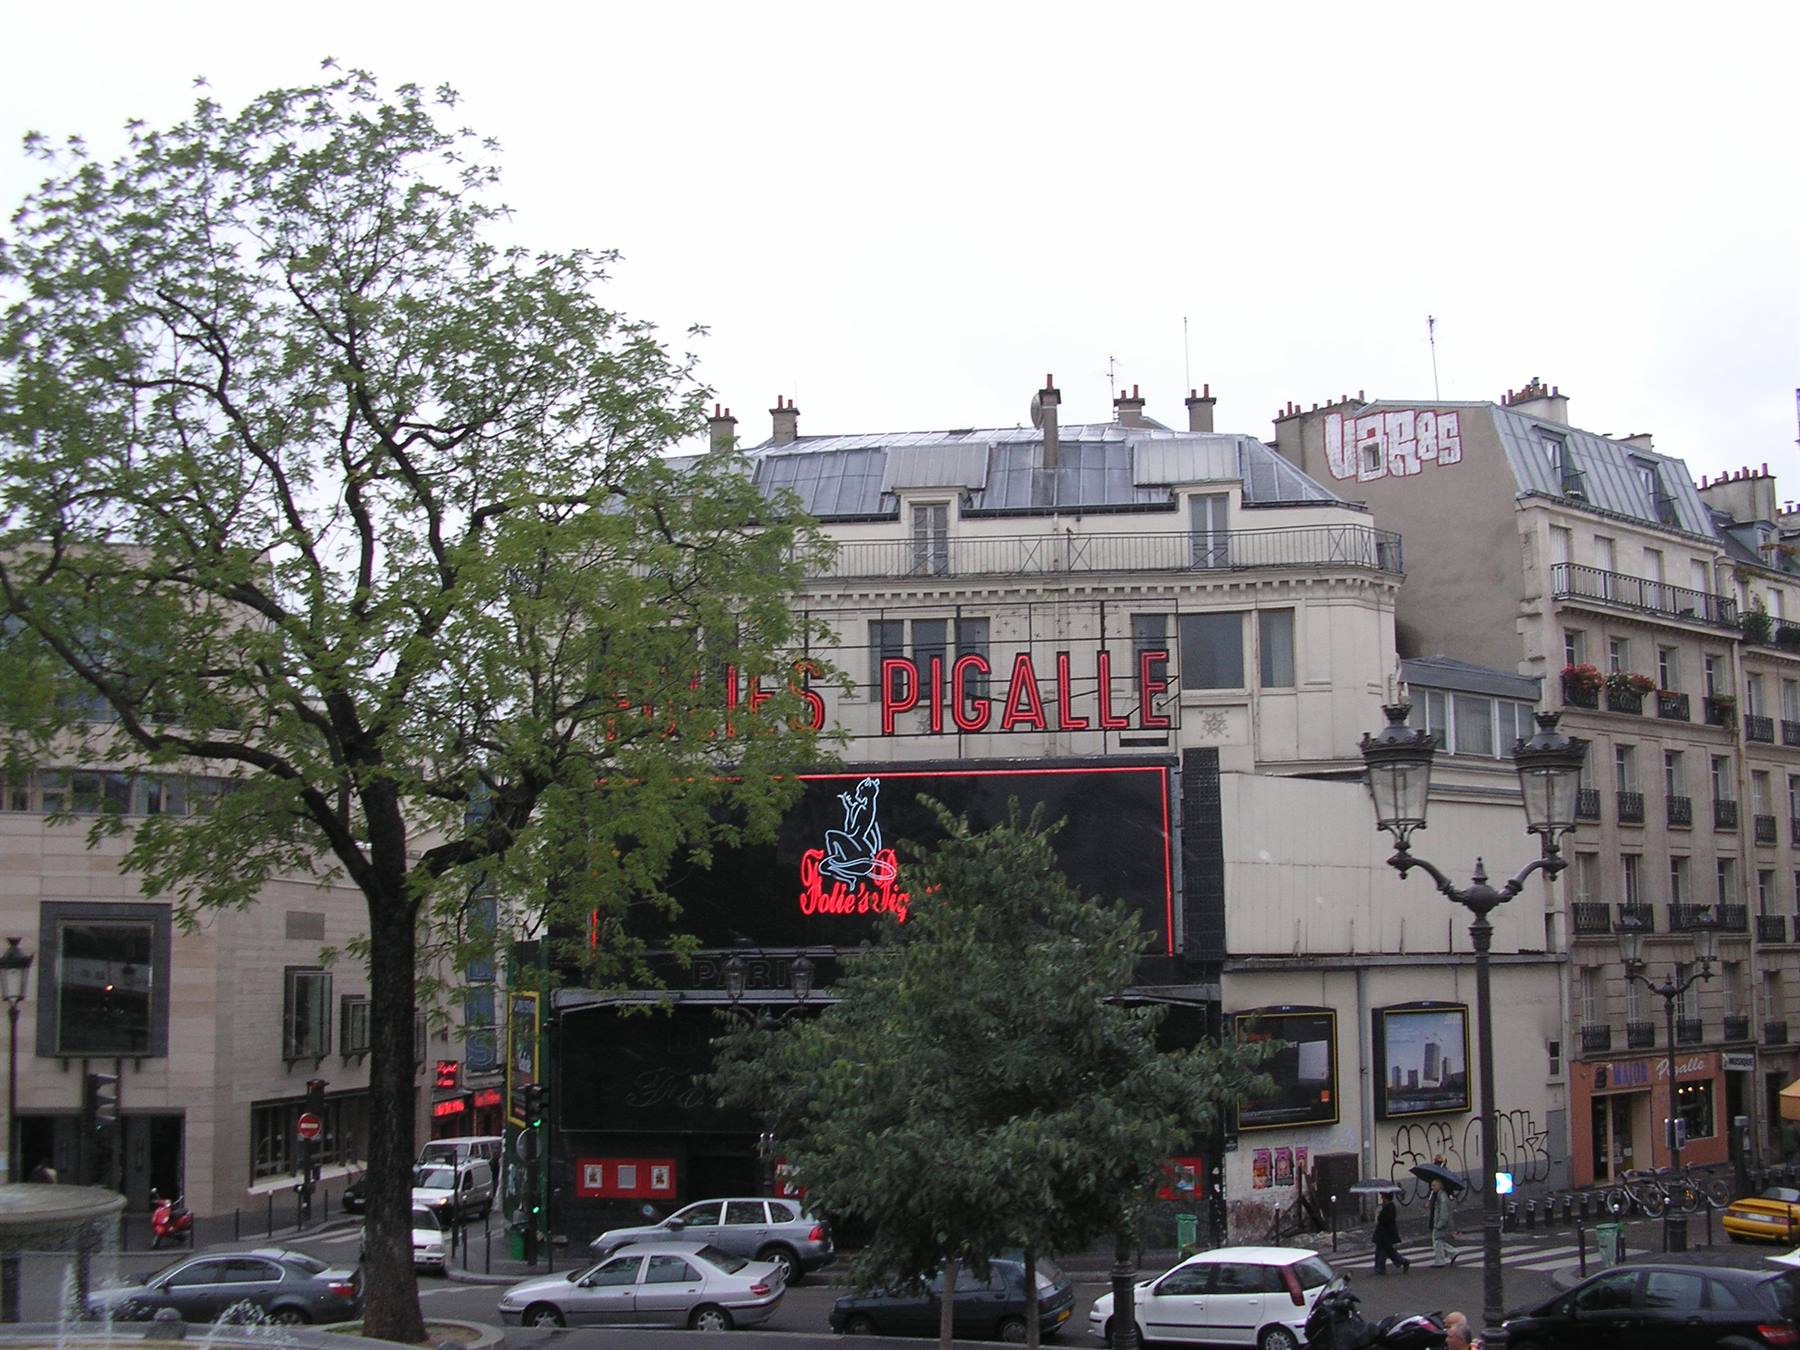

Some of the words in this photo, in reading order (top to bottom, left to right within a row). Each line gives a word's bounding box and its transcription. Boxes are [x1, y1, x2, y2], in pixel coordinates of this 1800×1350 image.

[880, 649, 1171, 735] PIGALLE
[799, 848, 870, 915] Folie's
[693, 959, 804, 988] PRI
